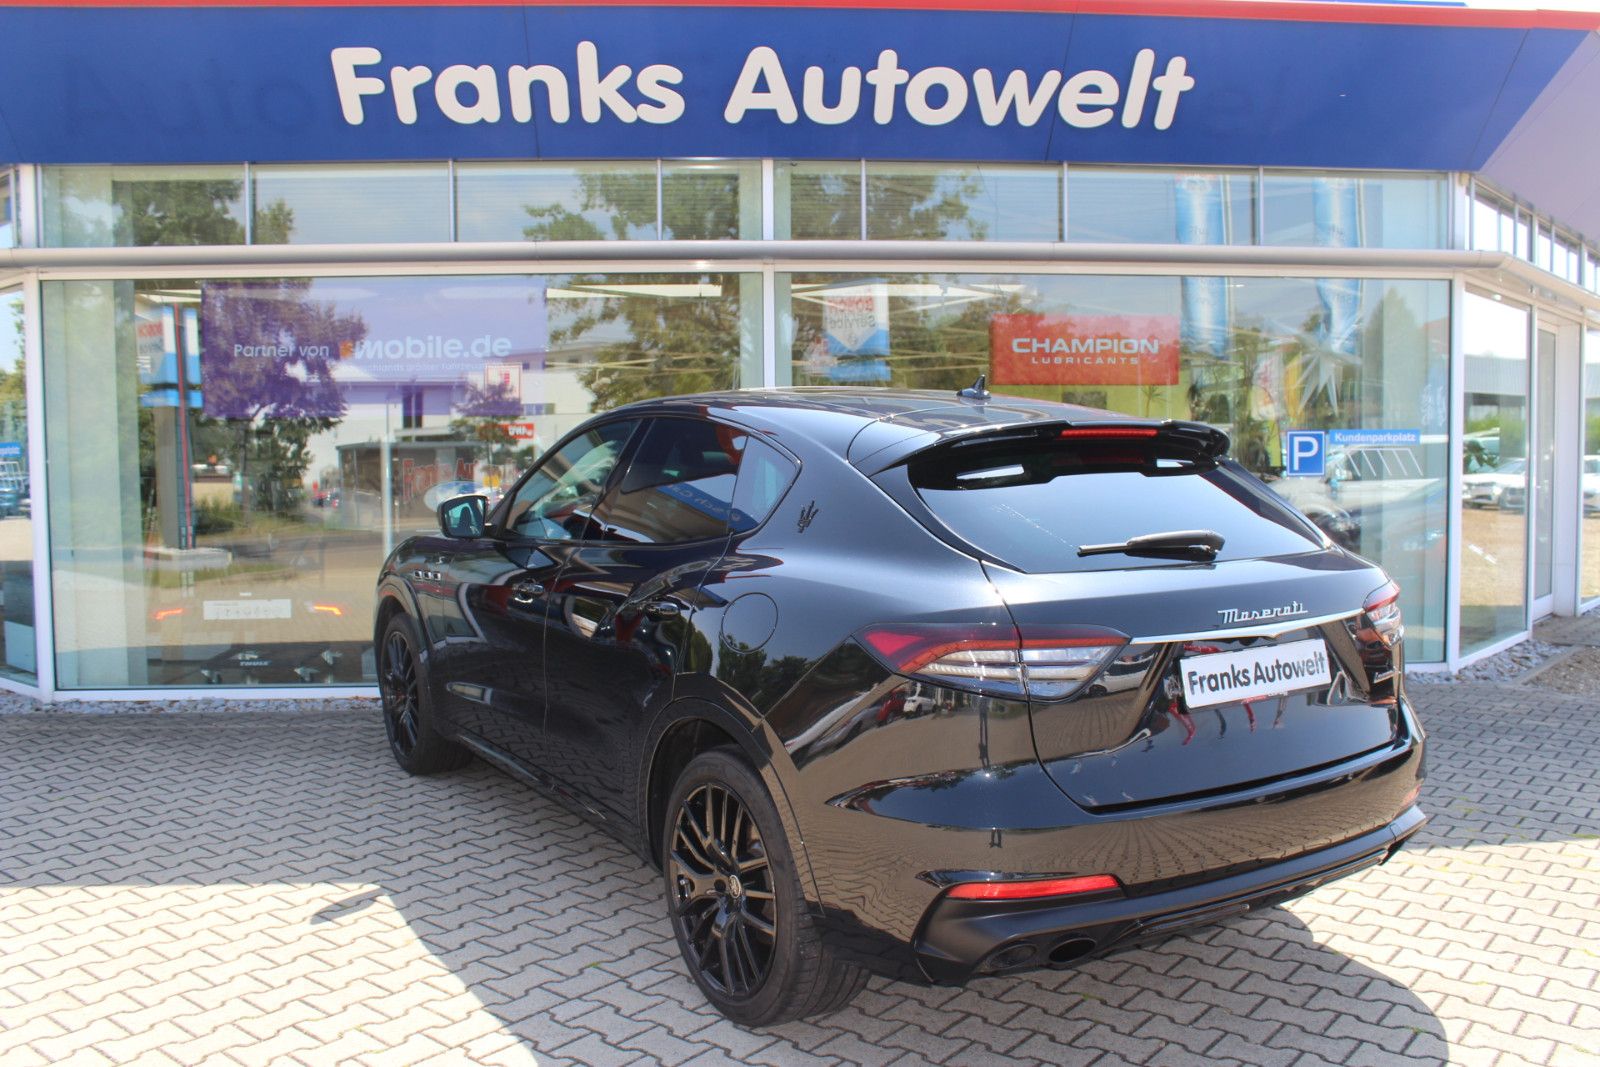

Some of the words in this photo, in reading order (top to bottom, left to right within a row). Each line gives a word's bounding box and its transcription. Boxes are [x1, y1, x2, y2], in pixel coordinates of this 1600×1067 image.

[330, 41, 686, 125] Franks
[724, 46, 1195, 130] Autowelt
[233, 343, 295, 357] Partner
[299, 345, 330, 357] von
[355, 334, 513, 360] mobile.de
[1011, 337, 1160, 355] CHAMPION
[1031, 356, 1139, 366] LUBRICANTS
[1334, 431, 1417, 445] Kundenparkplatz
[1292, 436, 1319, 471] P
[1217, 600, 1308, 624] Maserati
[1187, 663, 1250, 695] Franks
[1253, 651, 1326, 686] Autowelt
